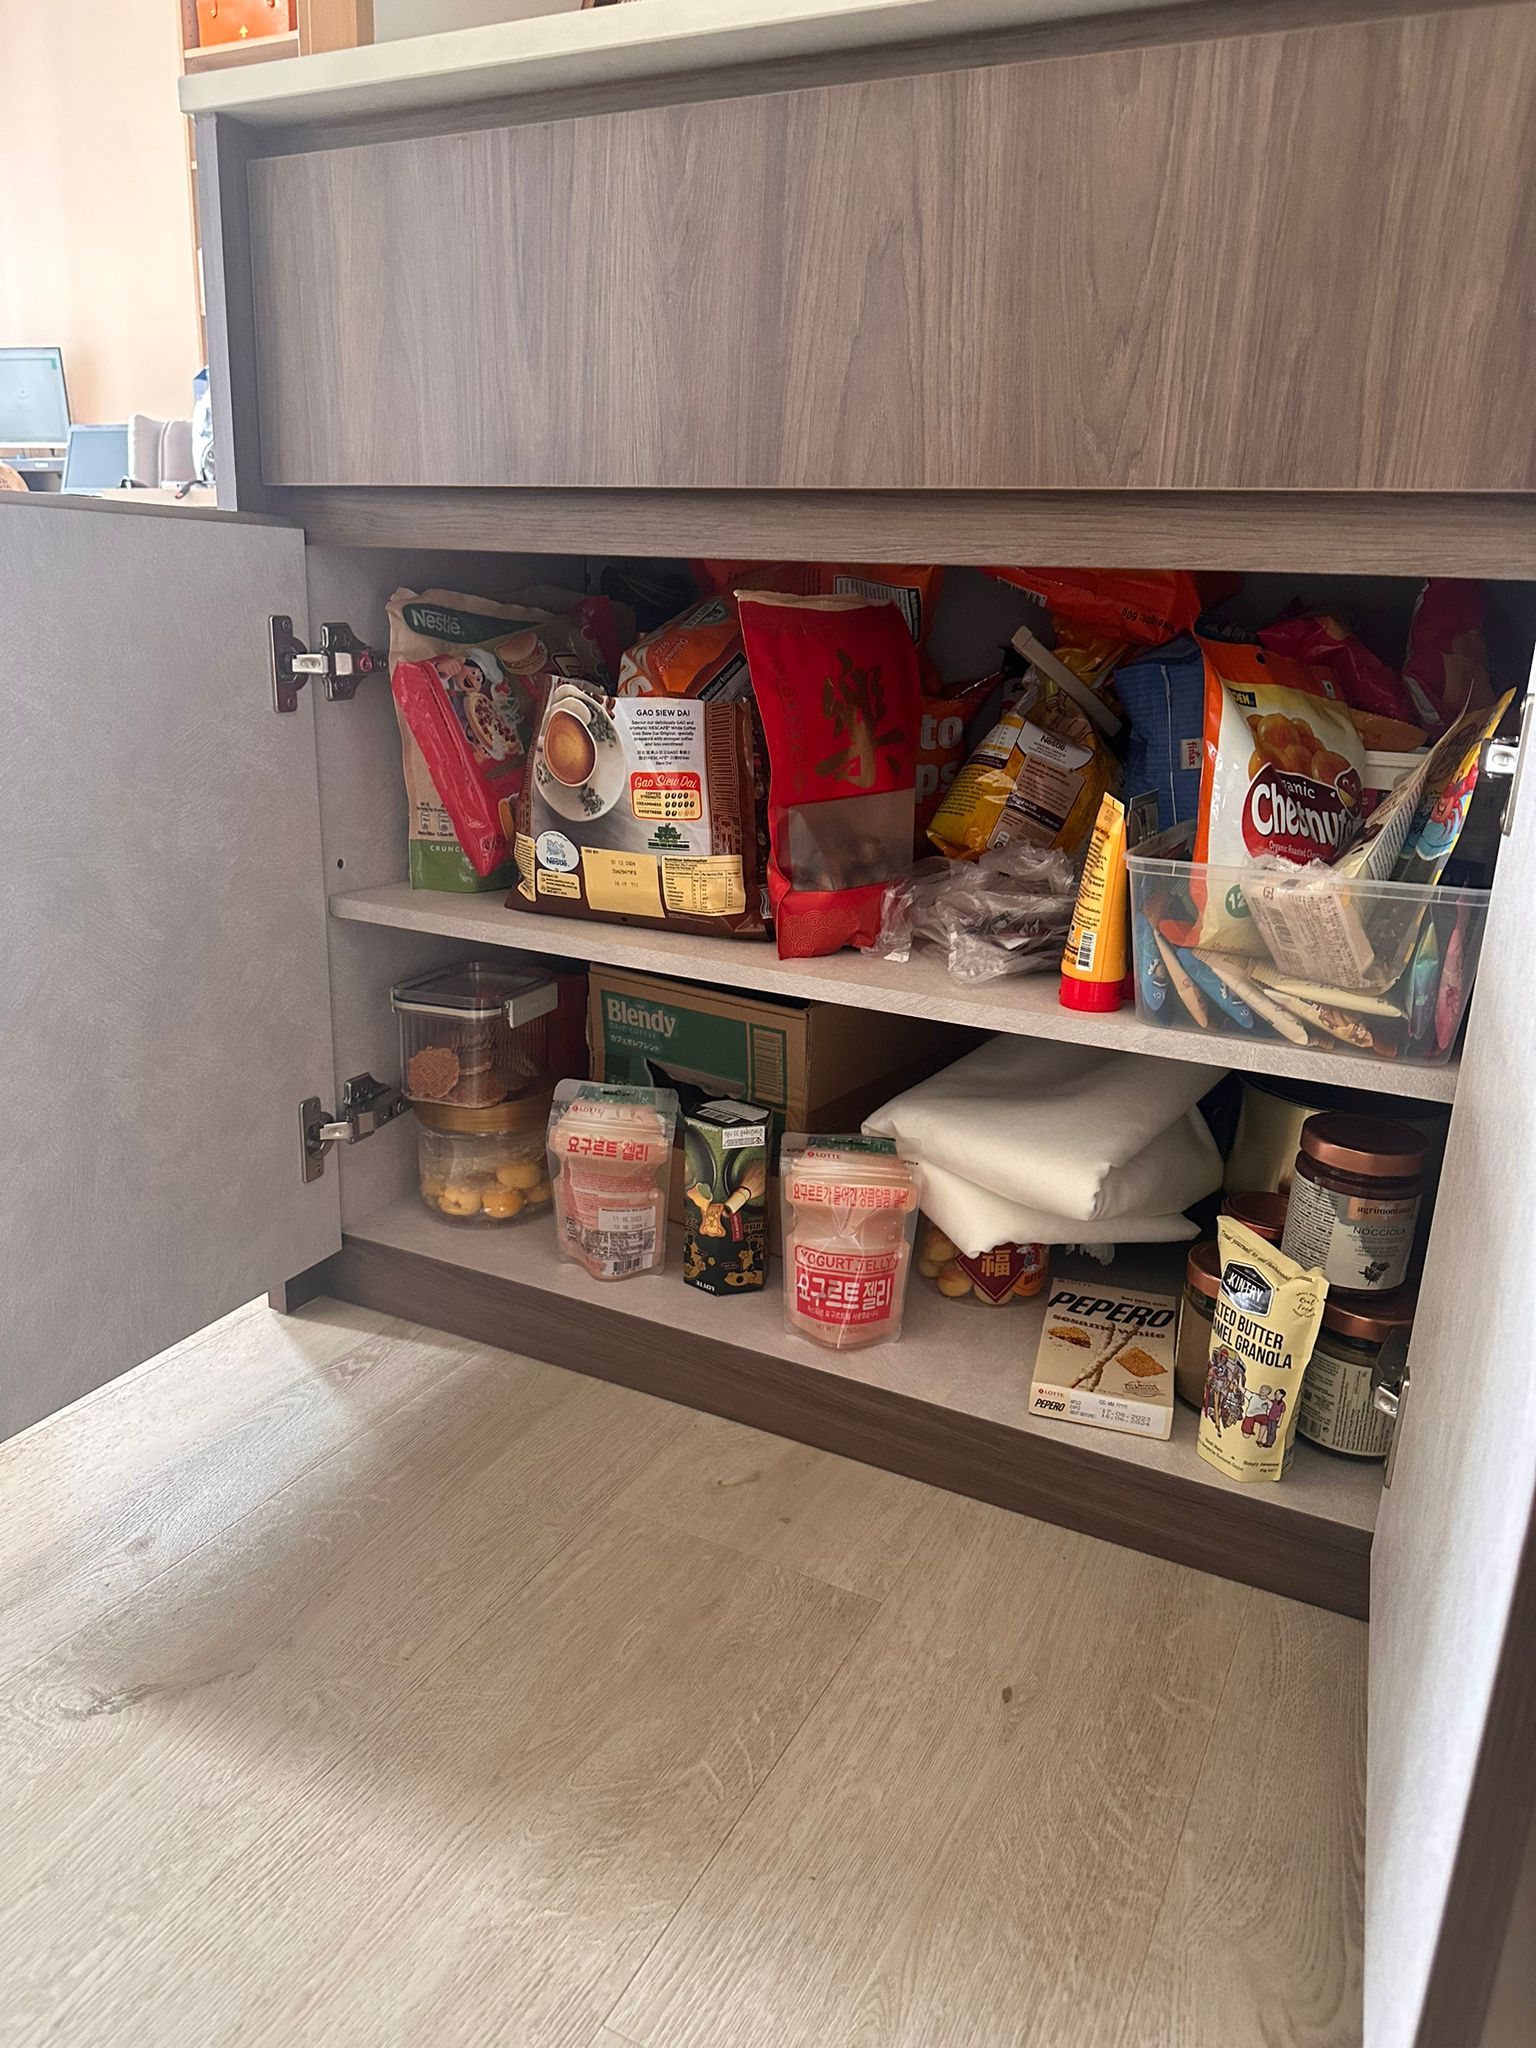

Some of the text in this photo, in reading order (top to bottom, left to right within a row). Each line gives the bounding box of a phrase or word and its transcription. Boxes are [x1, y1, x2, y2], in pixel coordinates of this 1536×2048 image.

[411, 608, 461, 635] Nestlé
[636, 709, 690, 717] GAO SIEW DAI
[635, 774, 697, 789] Gao Siew Dai
[1282, 779, 1316, 800] anic
[1269, 840, 1288, 854] Organic
[607, 997, 676, 1038] Blendy
[629, 1027, 656, 1039] COFFEE
[579, 1106, 602, 1114] LOTTE
[567, 1136, 649, 1162] 요구르트 젤리
[816, 1152, 841, 1160] LOTTE
[793, 1183, 832, 1207] 요구르트가
[833, 1186, 858, 1208] 들어간
[1231, 1238, 1253, 1255] yourself
[801, 1248, 894, 1272] YOGURT JELLY
[980, 1249, 1011, 1277] 福
[695, 1279, 715, 1292] LOTTE
[797, 1272, 891, 1311] 요구르트 젤리
[1048, 1291, 1175, 1328] PEPERO
[1053, 1314, 1116, 1332] sesame
[1237, 1314, 1284, 1350] BUTTER
[1235, 1334, 1292, 1369] GRANOLA
[1044, 1390, 1065, 1398] LOTTE
[1034, 1398, 1066, 1412] PEPERO
